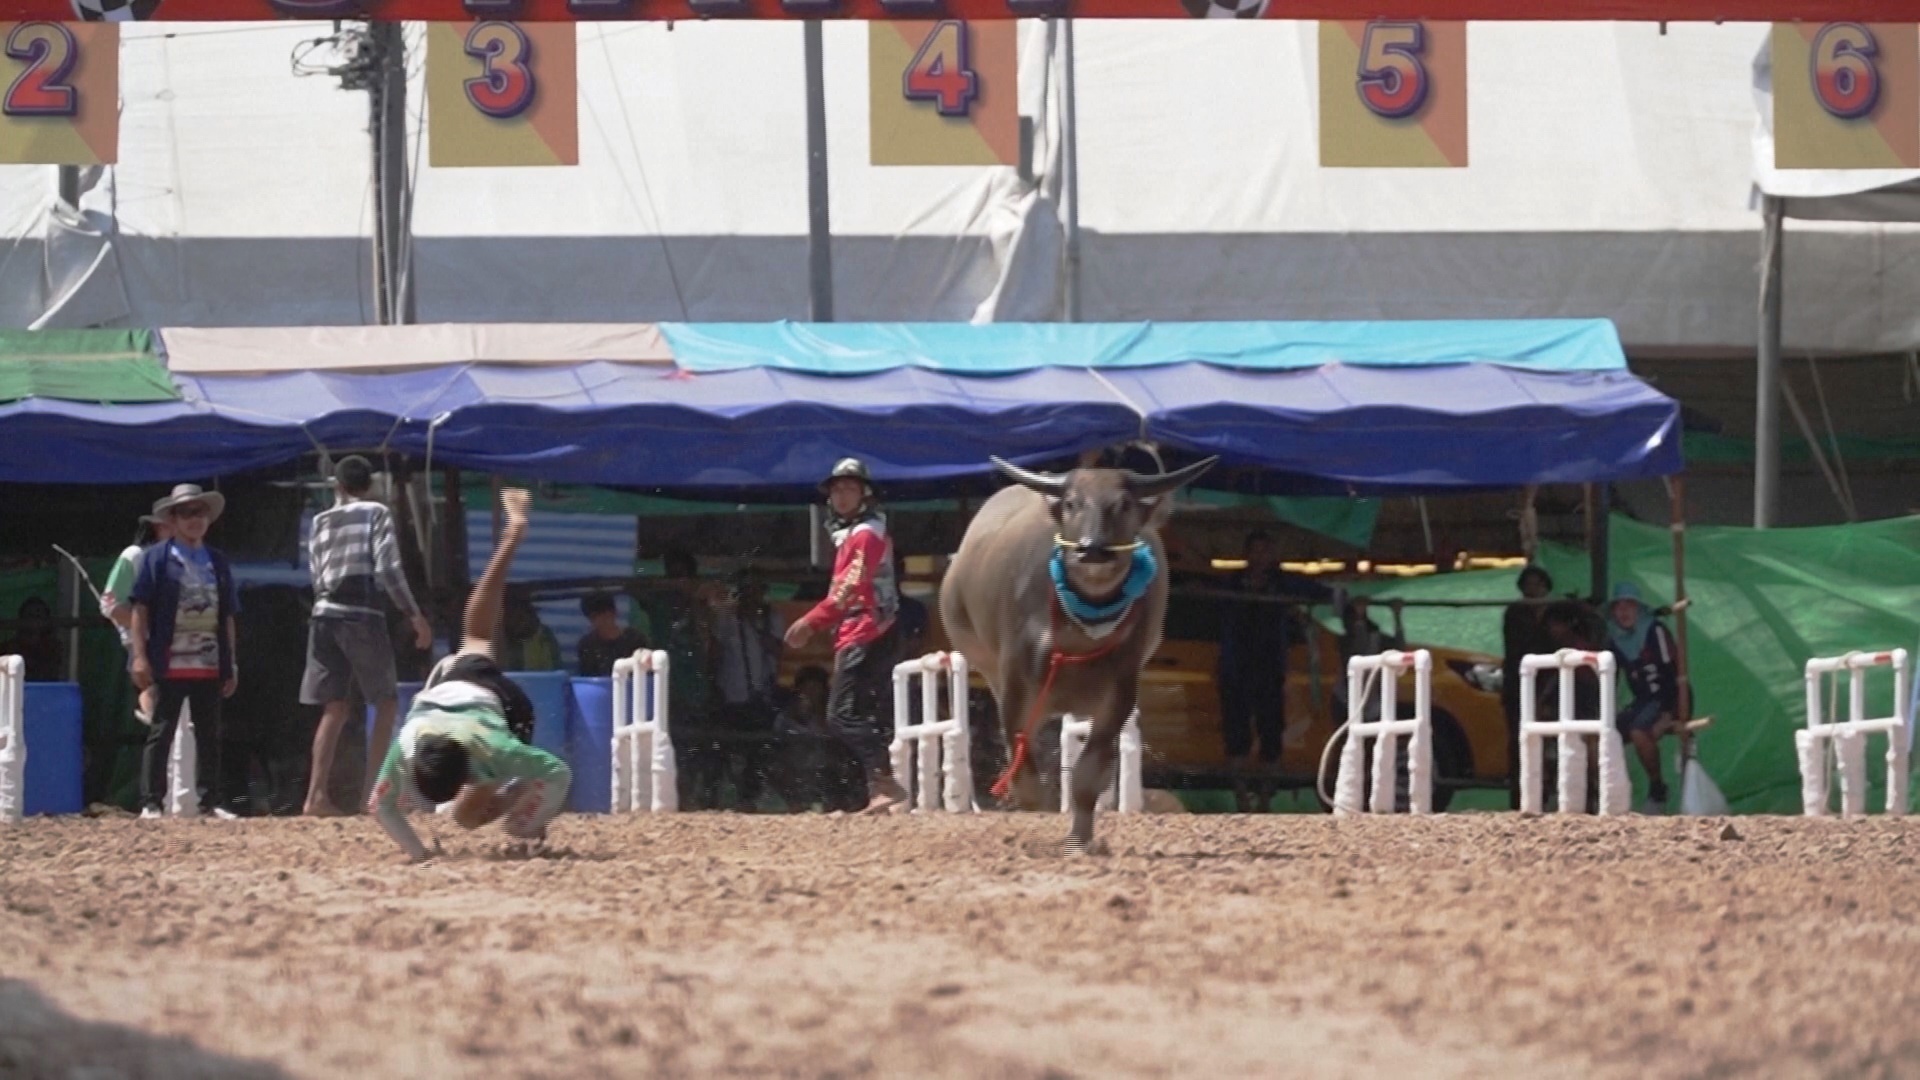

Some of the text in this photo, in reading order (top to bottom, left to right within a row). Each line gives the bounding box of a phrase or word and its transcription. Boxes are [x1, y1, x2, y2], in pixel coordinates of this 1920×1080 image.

[2, 21, 77, 116] 2
[464, 20, 536, 118] 3
[902, 19, 978, 117] 4
[1356, 20, 1429, 119] 5
[1810, 21, 1882, 120] 6
